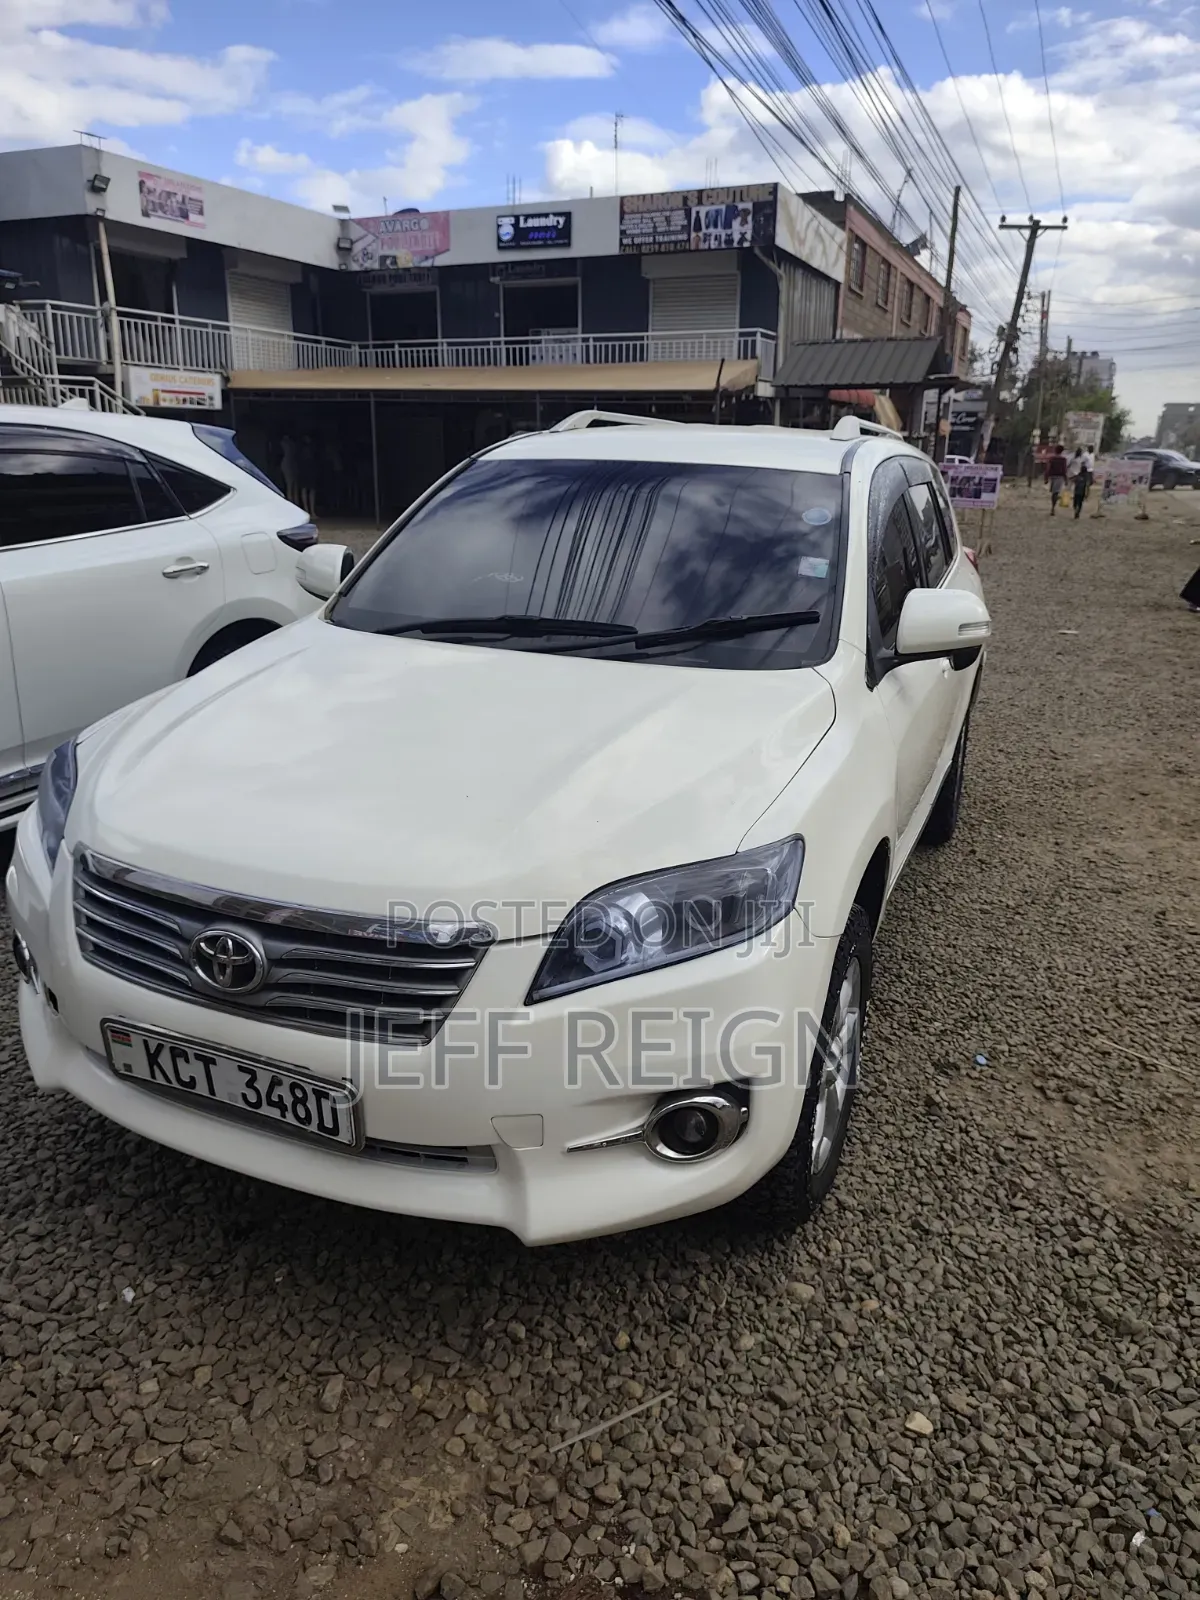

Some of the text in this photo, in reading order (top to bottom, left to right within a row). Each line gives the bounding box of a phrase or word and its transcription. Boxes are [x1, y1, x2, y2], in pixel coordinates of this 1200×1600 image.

[622, 183, 774, 213] SHARON'S COUTURE
[379, 217, 430, 234] AVARGO
[519, 214, 566, 229] Laundry
[143, 1038, 340, 1137] KCT 348D
